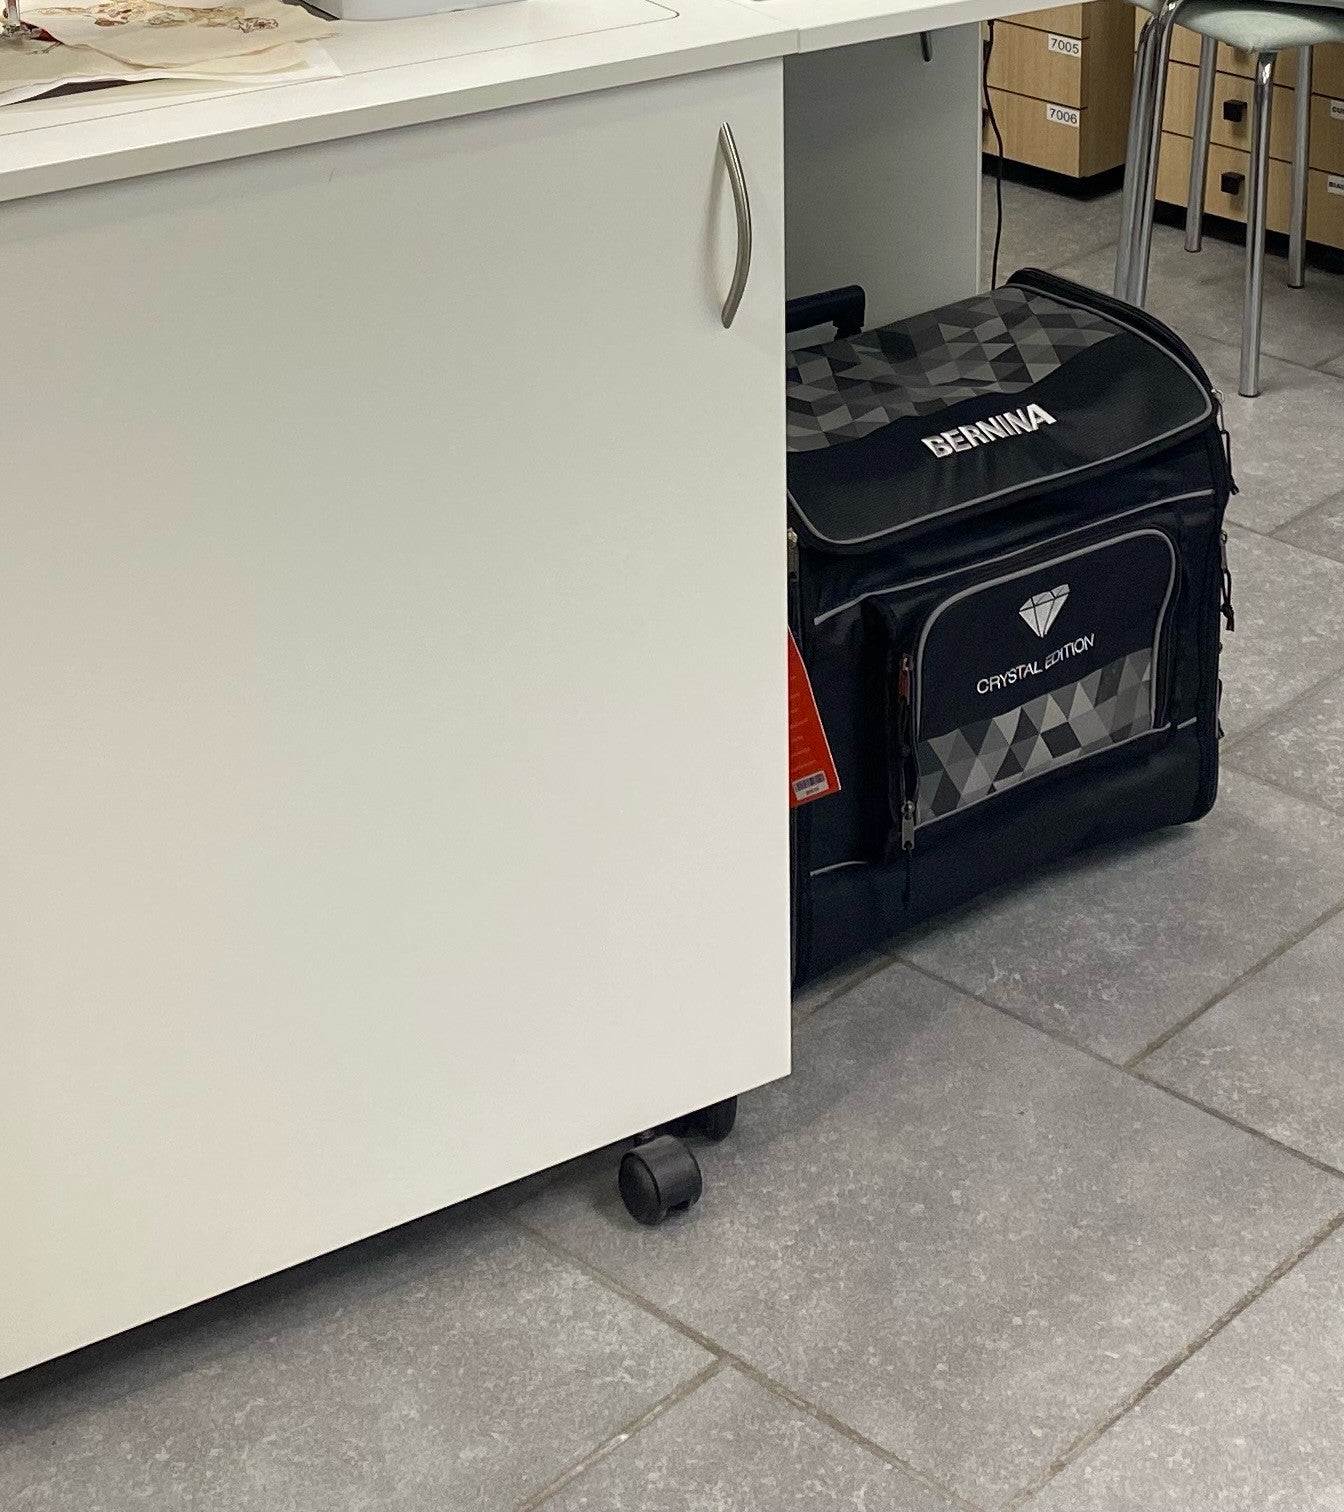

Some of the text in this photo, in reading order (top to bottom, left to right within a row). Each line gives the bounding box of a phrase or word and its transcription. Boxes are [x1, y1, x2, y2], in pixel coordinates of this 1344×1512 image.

[1050, 37, 1080, 55] 7005
[1049, 107, 1078, 125] 7006
[922, 401, 1057, 460] BERNINA
[976, 632, 1096, 696] CRYSTAL EDITION
